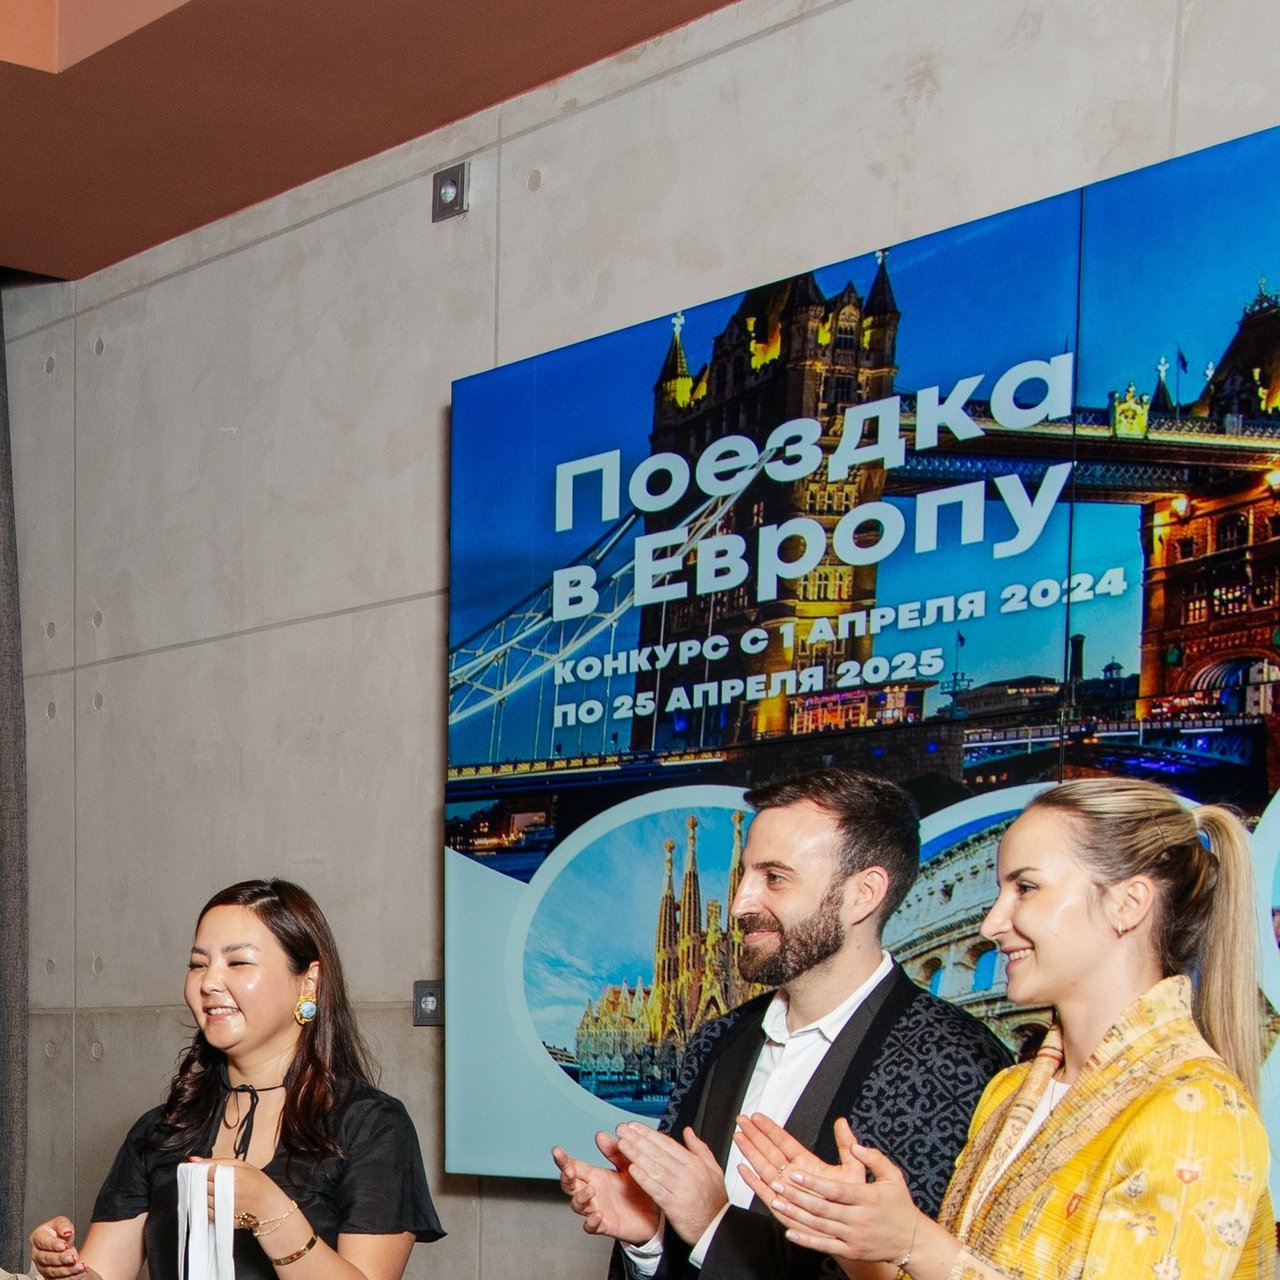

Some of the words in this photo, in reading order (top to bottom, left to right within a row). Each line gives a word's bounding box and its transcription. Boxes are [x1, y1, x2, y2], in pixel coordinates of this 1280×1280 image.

[555, 351, 1074, 532] Поездка
[552, 564, 599, 622] в
[634, 461, 1072, 606] Европу
[553, 633, 730, 685] КОНКУРС
[740, 627, 769, 655] С
[779, 622, 795, 648] 1
[807, 590, 986, 645] АПРЕЛЯ
[999, 566, 1128, 614] 2024
[553, 698, 604, 728] ПО
[612, 691, 656, 720] 25
[664, 665, 824, 713] АПРЕЛЯ
[836, 647, 944, 688] 2025
